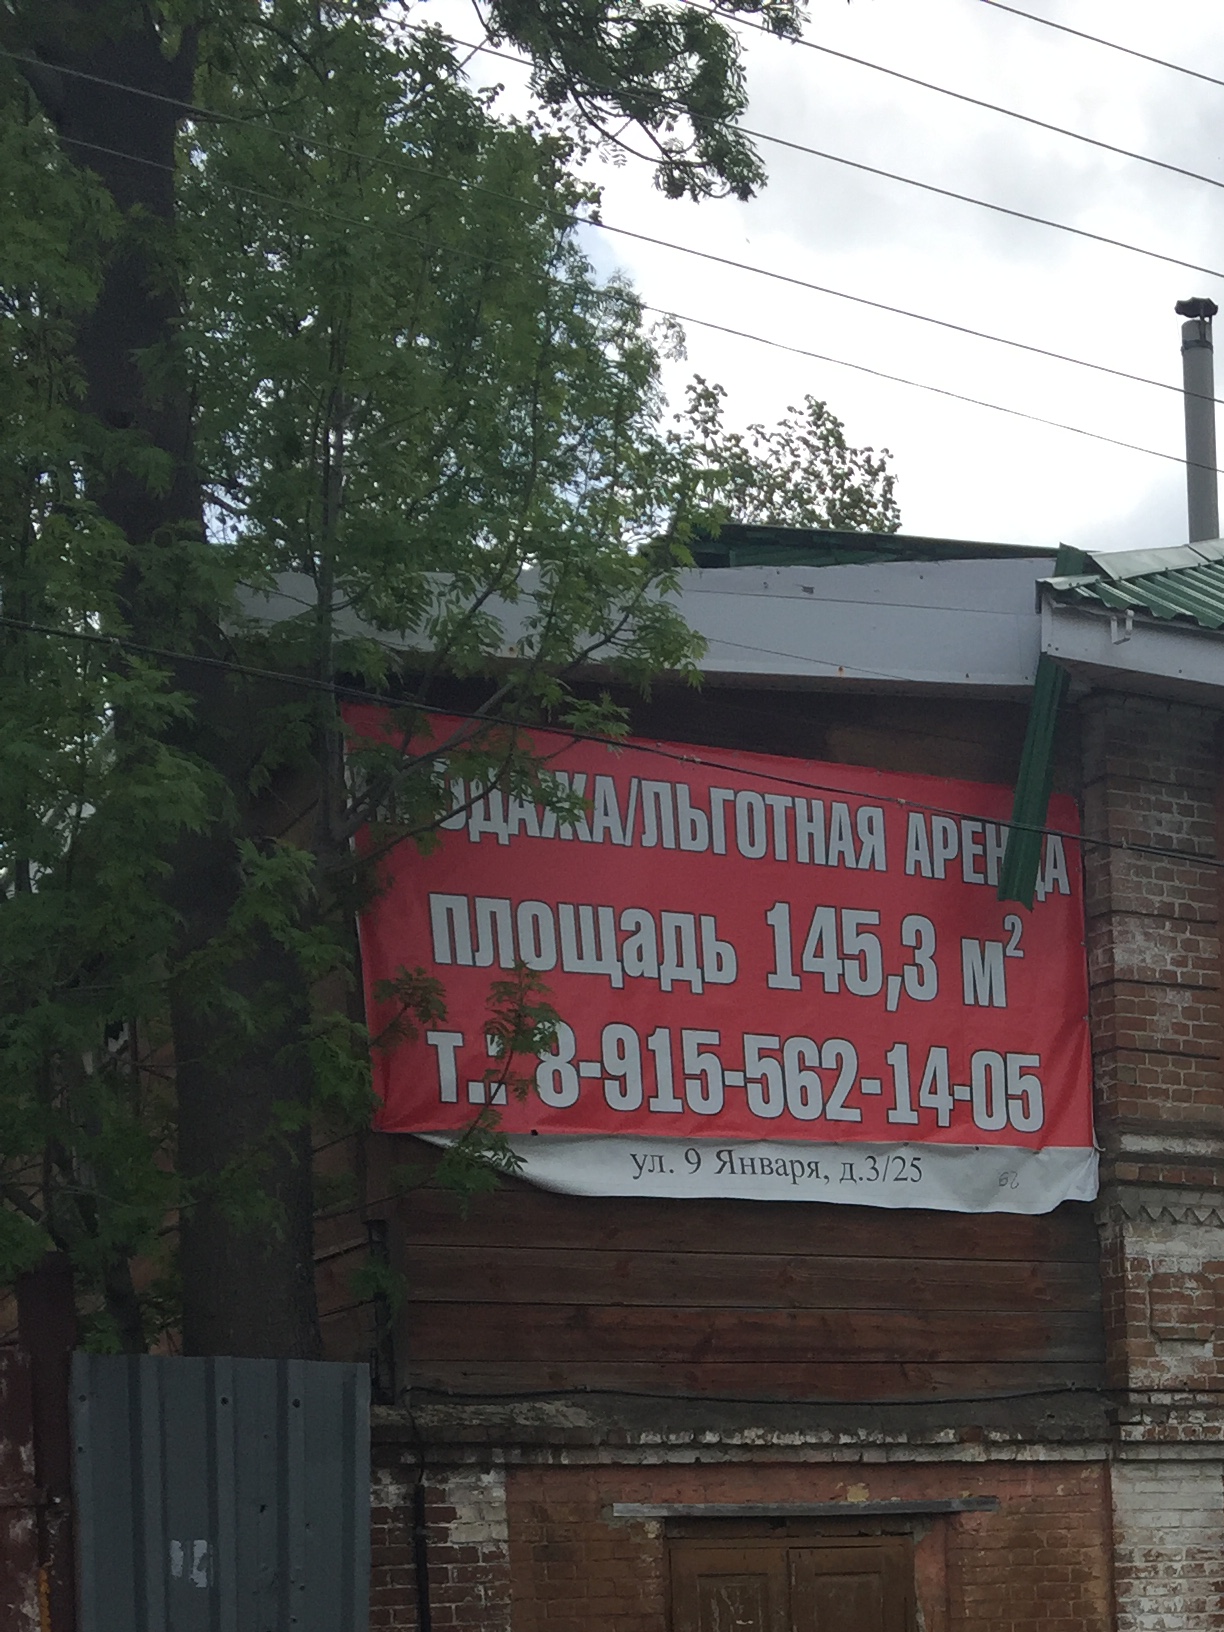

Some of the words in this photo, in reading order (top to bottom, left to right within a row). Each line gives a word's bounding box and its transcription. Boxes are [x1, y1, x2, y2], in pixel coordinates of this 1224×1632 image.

[350, 757, 888, 873] ОДАЖА/ЛЬГОТНАЯ
[904, 810, 1072, 902] АРЕНА
[765, 901, 938, 1012] 145,3
[535, 1019, 1045, 1133] 8-915-562-14-05
[630, 1152, 674, 1180] ул.
[684, 1147, 703, 1175] 9
[714, 1149, 830, 1185] Января,
[839, 1154, 924, 1184] д.3/25
